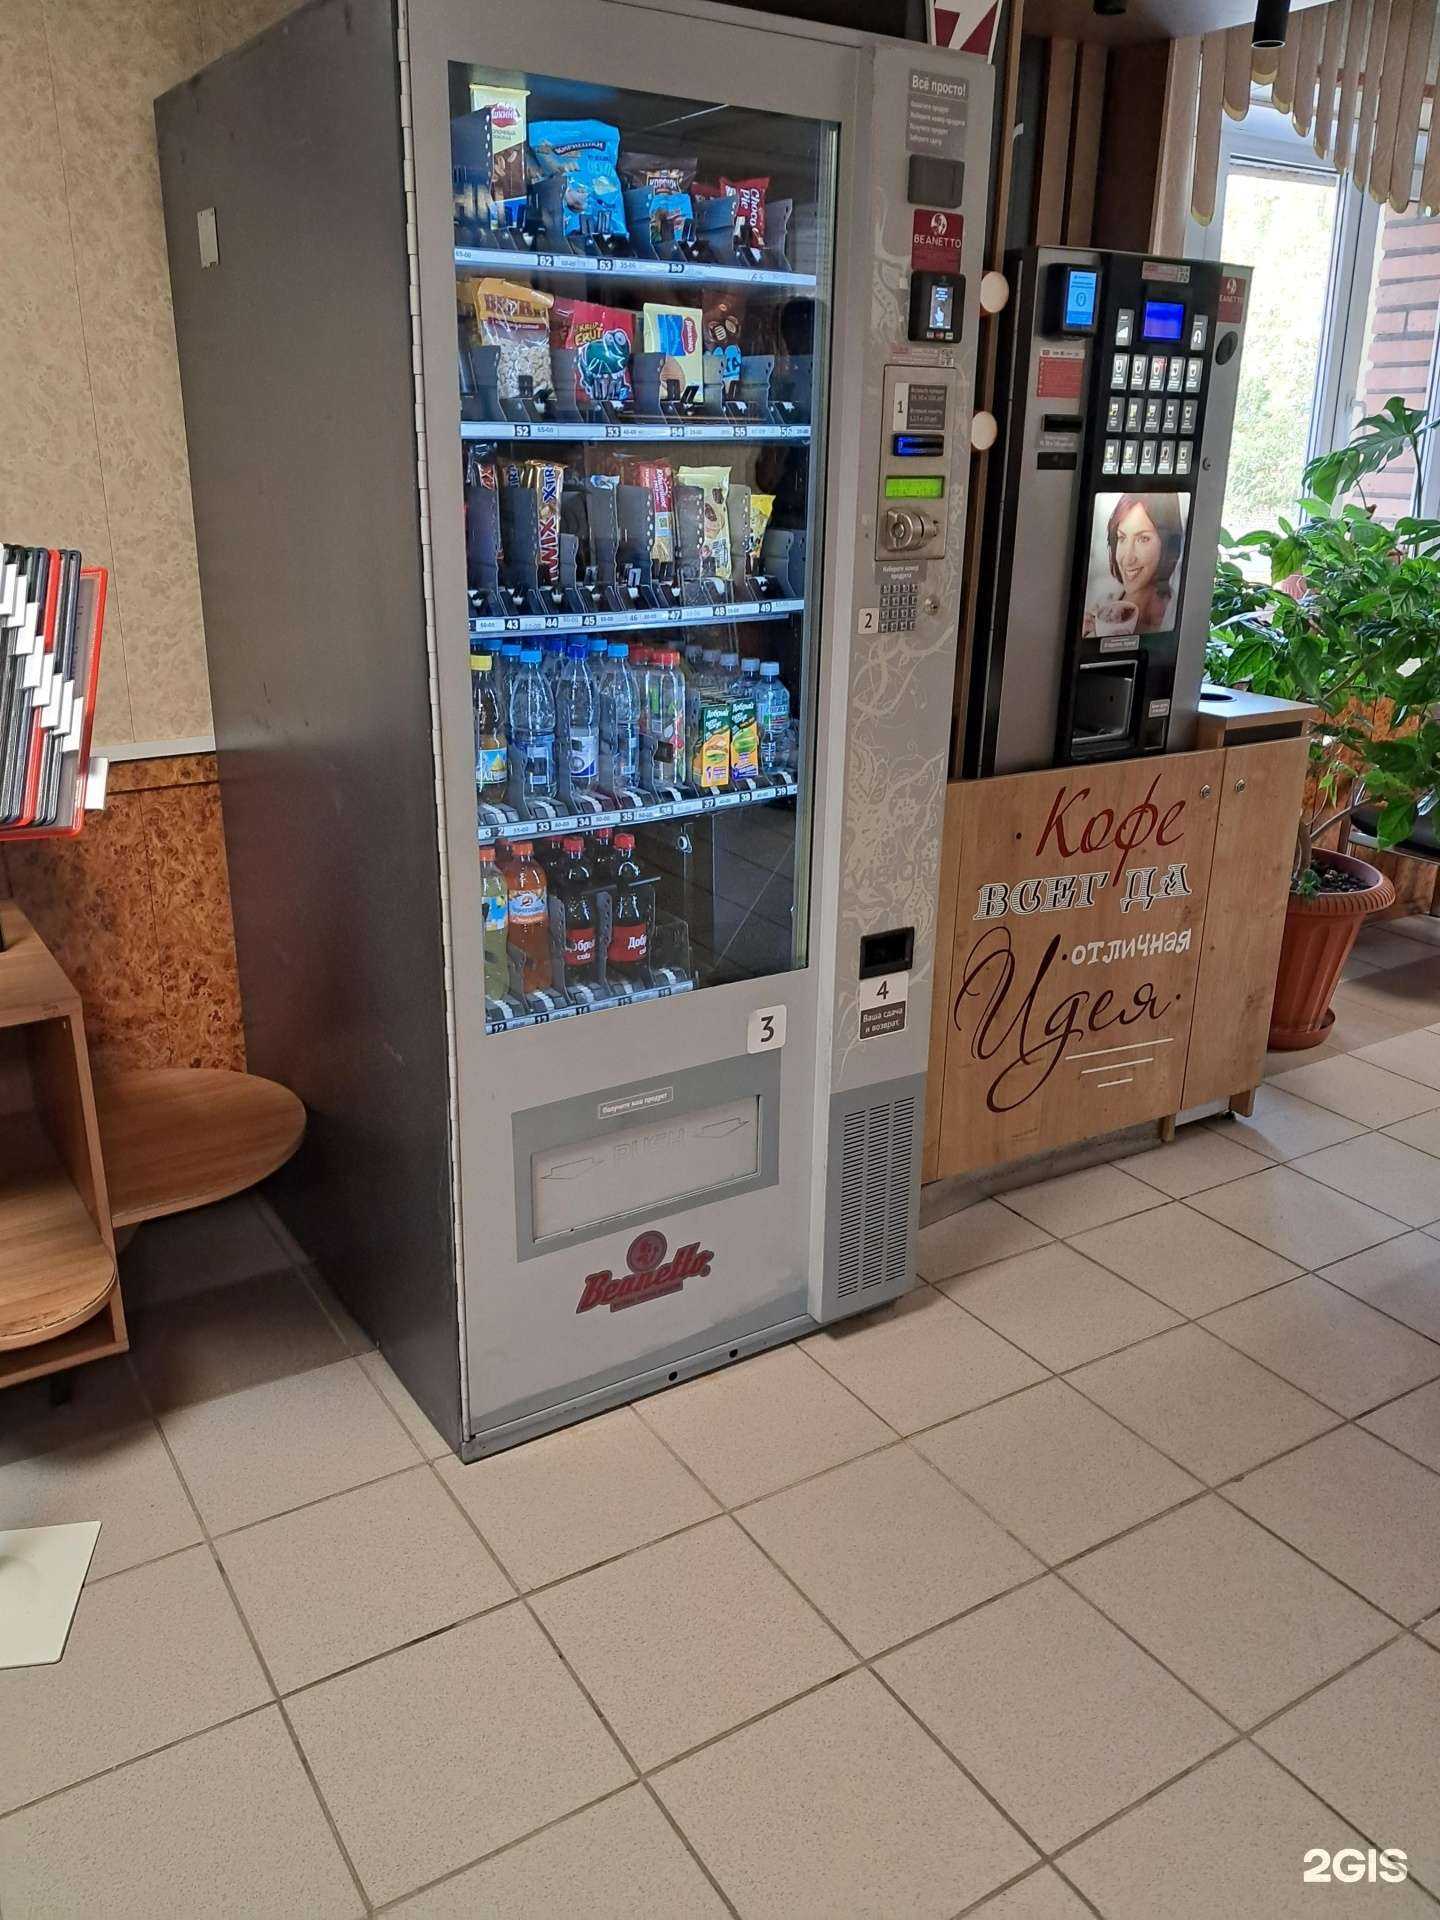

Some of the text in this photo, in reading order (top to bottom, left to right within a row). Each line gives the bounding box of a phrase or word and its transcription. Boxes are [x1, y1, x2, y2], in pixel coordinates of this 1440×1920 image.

[912, 75, 966, 97] Всё просто!
[740, 188, 749, 210] Pie
[750, 188, 760, 230] Choco
[913, 233, 962, 249] BEANETTO
[516, 426, 529, 437] 52
[607, 427, 619, 437] 53
[735, 427, 746, 437] 55
[714, 607, 725, 616] 48
[760, 603, 771, 612] 49
[507, 619, 519, 630] 43
[546, 617, 557, 628] 44
[584, 616, 596, 626] 45
[864, 612, 873, 629] 2
[776, 787, 787, 796] 39
[578, 818, 590, 827] 34
[622, 813, 633, 822] 35
[538, 822, 550, 831] 33
[1036, 773, 1186, 888] Кофе
[1071, 928, 1192, 966] отличная
[876, 980, 889, 1001] 4
[863, 1013, 881, 1023] Ваша
[954, 926, 1171, 1113] Идея
[760, 1015, 775, 1043] 3
